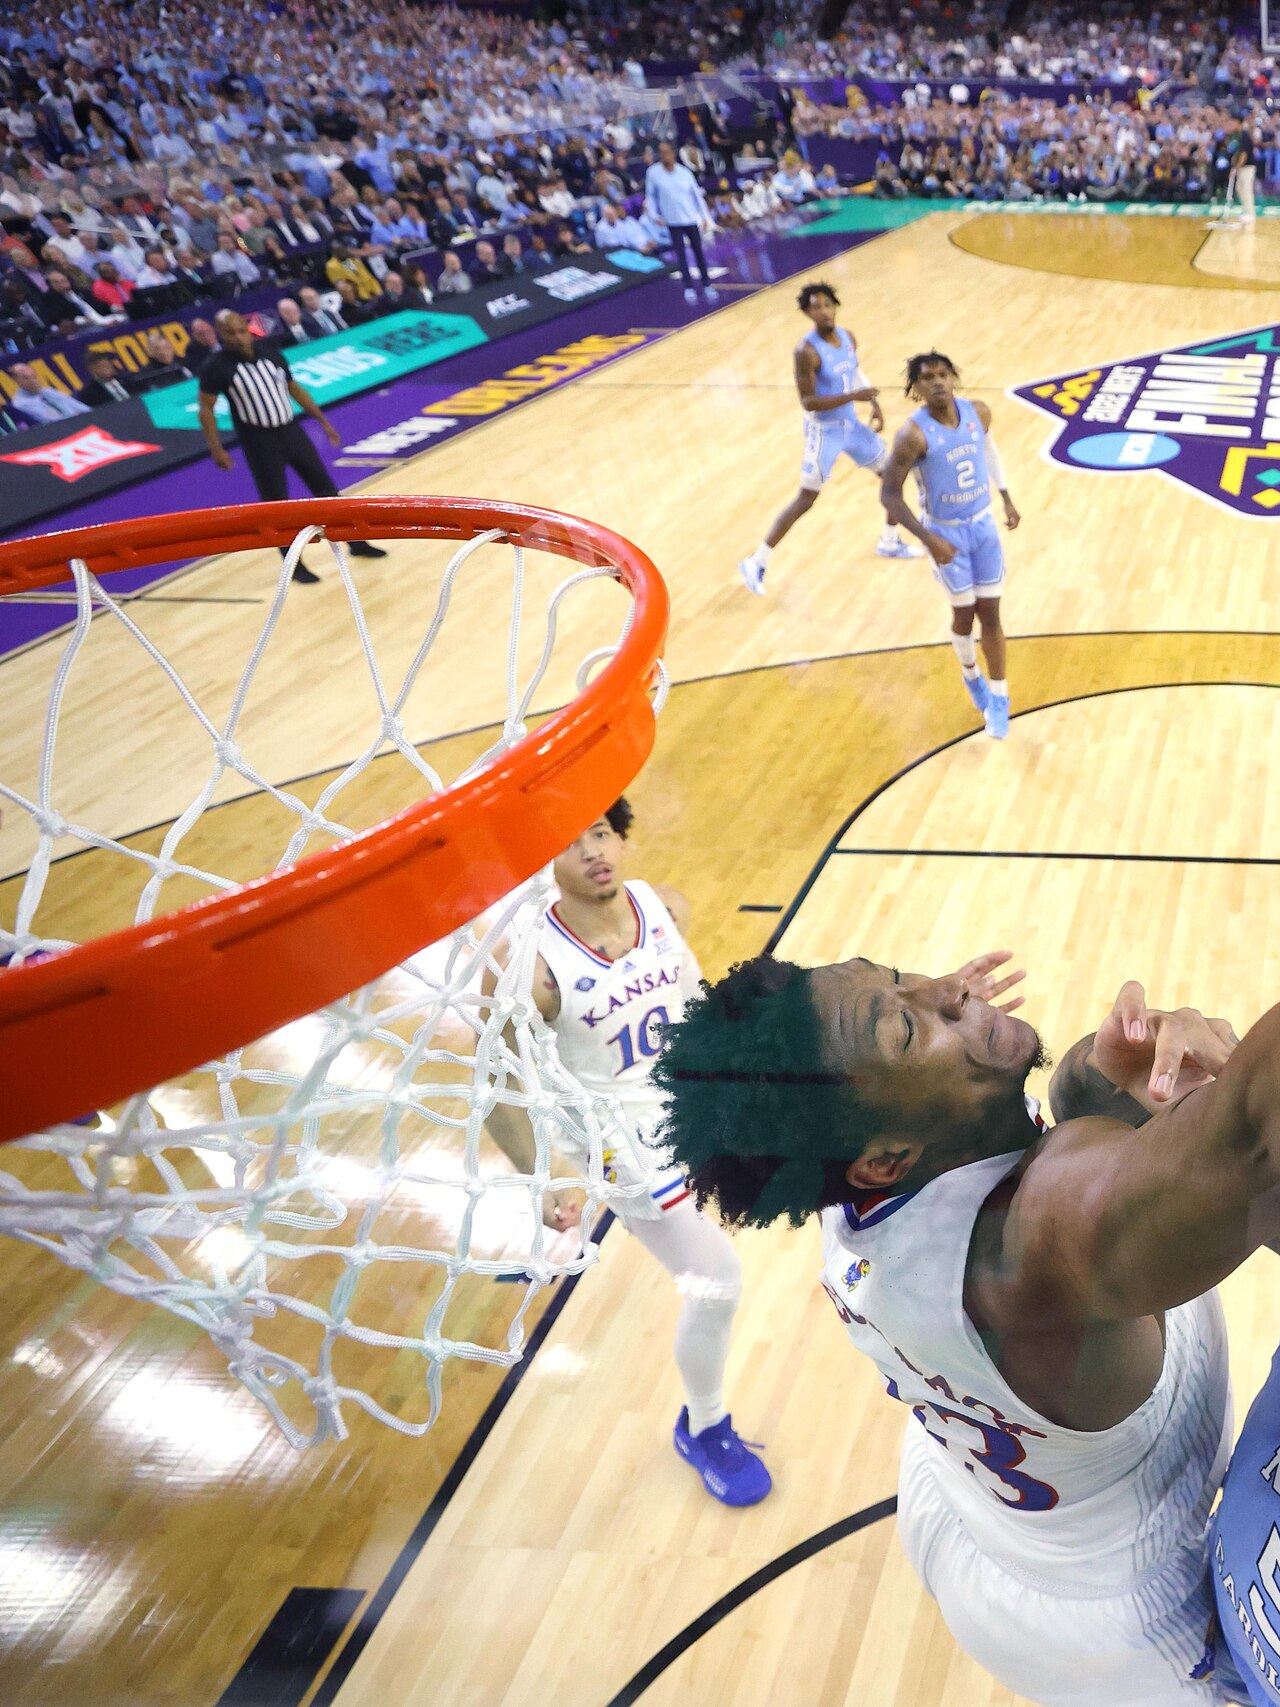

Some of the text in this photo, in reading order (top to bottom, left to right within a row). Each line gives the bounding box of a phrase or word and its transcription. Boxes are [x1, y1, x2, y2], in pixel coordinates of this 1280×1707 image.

[421, 334, 647, 416] ORLEANS
[1124, 353, 1268, 438] FINAL
[945, 443, 977, 463] NORTH
[956, 460, 976, 489] 2
[580, 964, 681, 1028] KANSAS
[606, 1005, 671, 1078] 10
